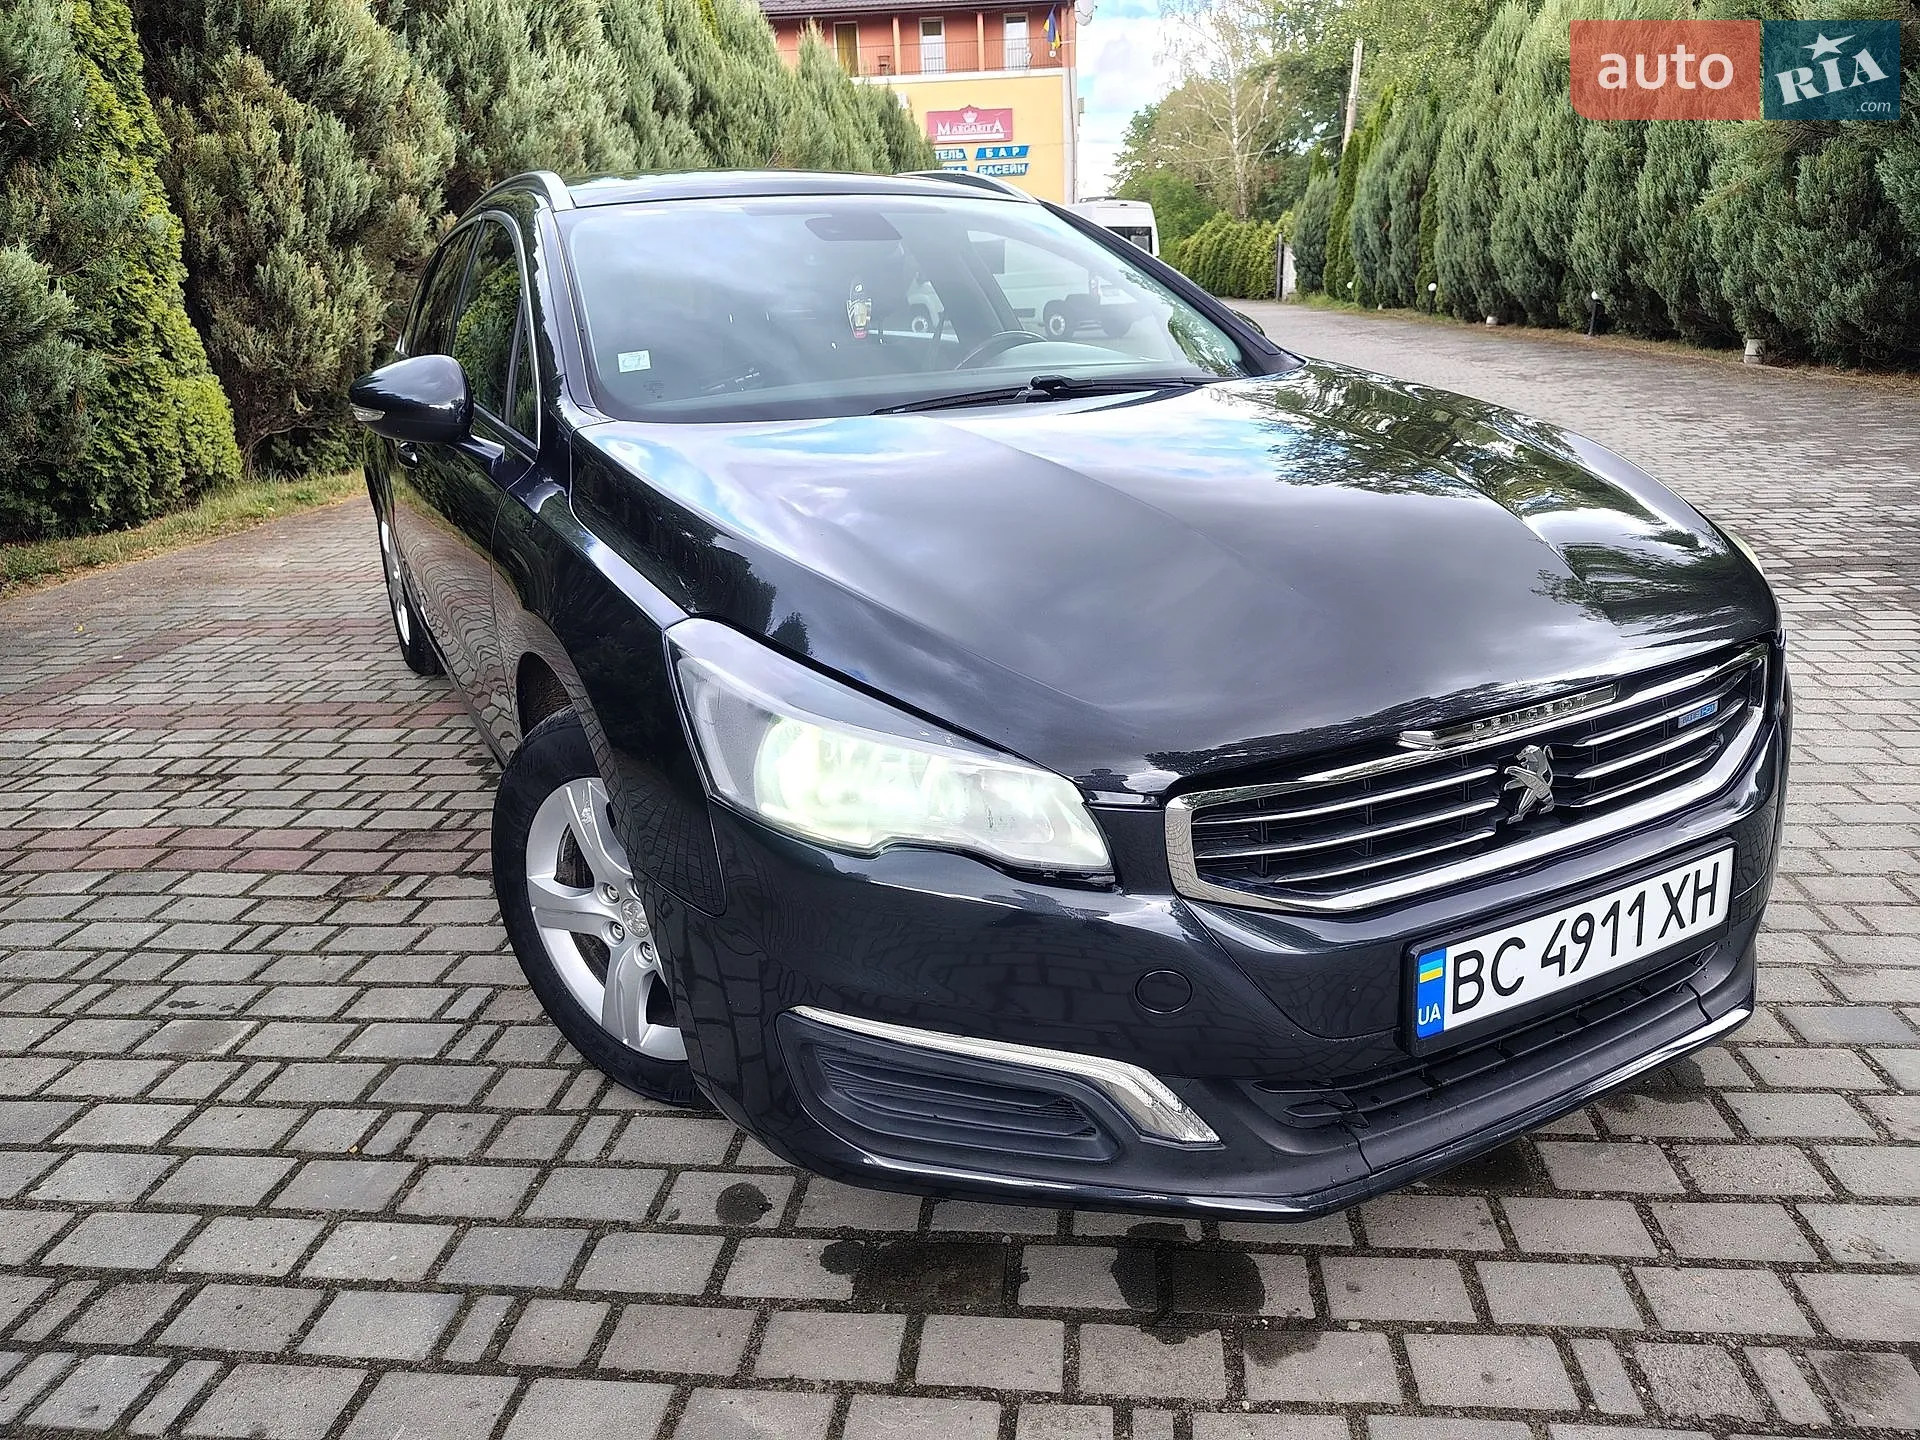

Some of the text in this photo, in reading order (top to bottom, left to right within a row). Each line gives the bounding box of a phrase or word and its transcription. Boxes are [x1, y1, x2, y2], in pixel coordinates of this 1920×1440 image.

[986, 147, 1019, 158] БАР
[979, 164, 1025, 174] БАСЕЙН
[1472, 693, 1587, 734] PEUGEOT
[1452, 862, 1719, 1014] BC 4911 XH
[1418, 1002, 1441, 1026] UA
